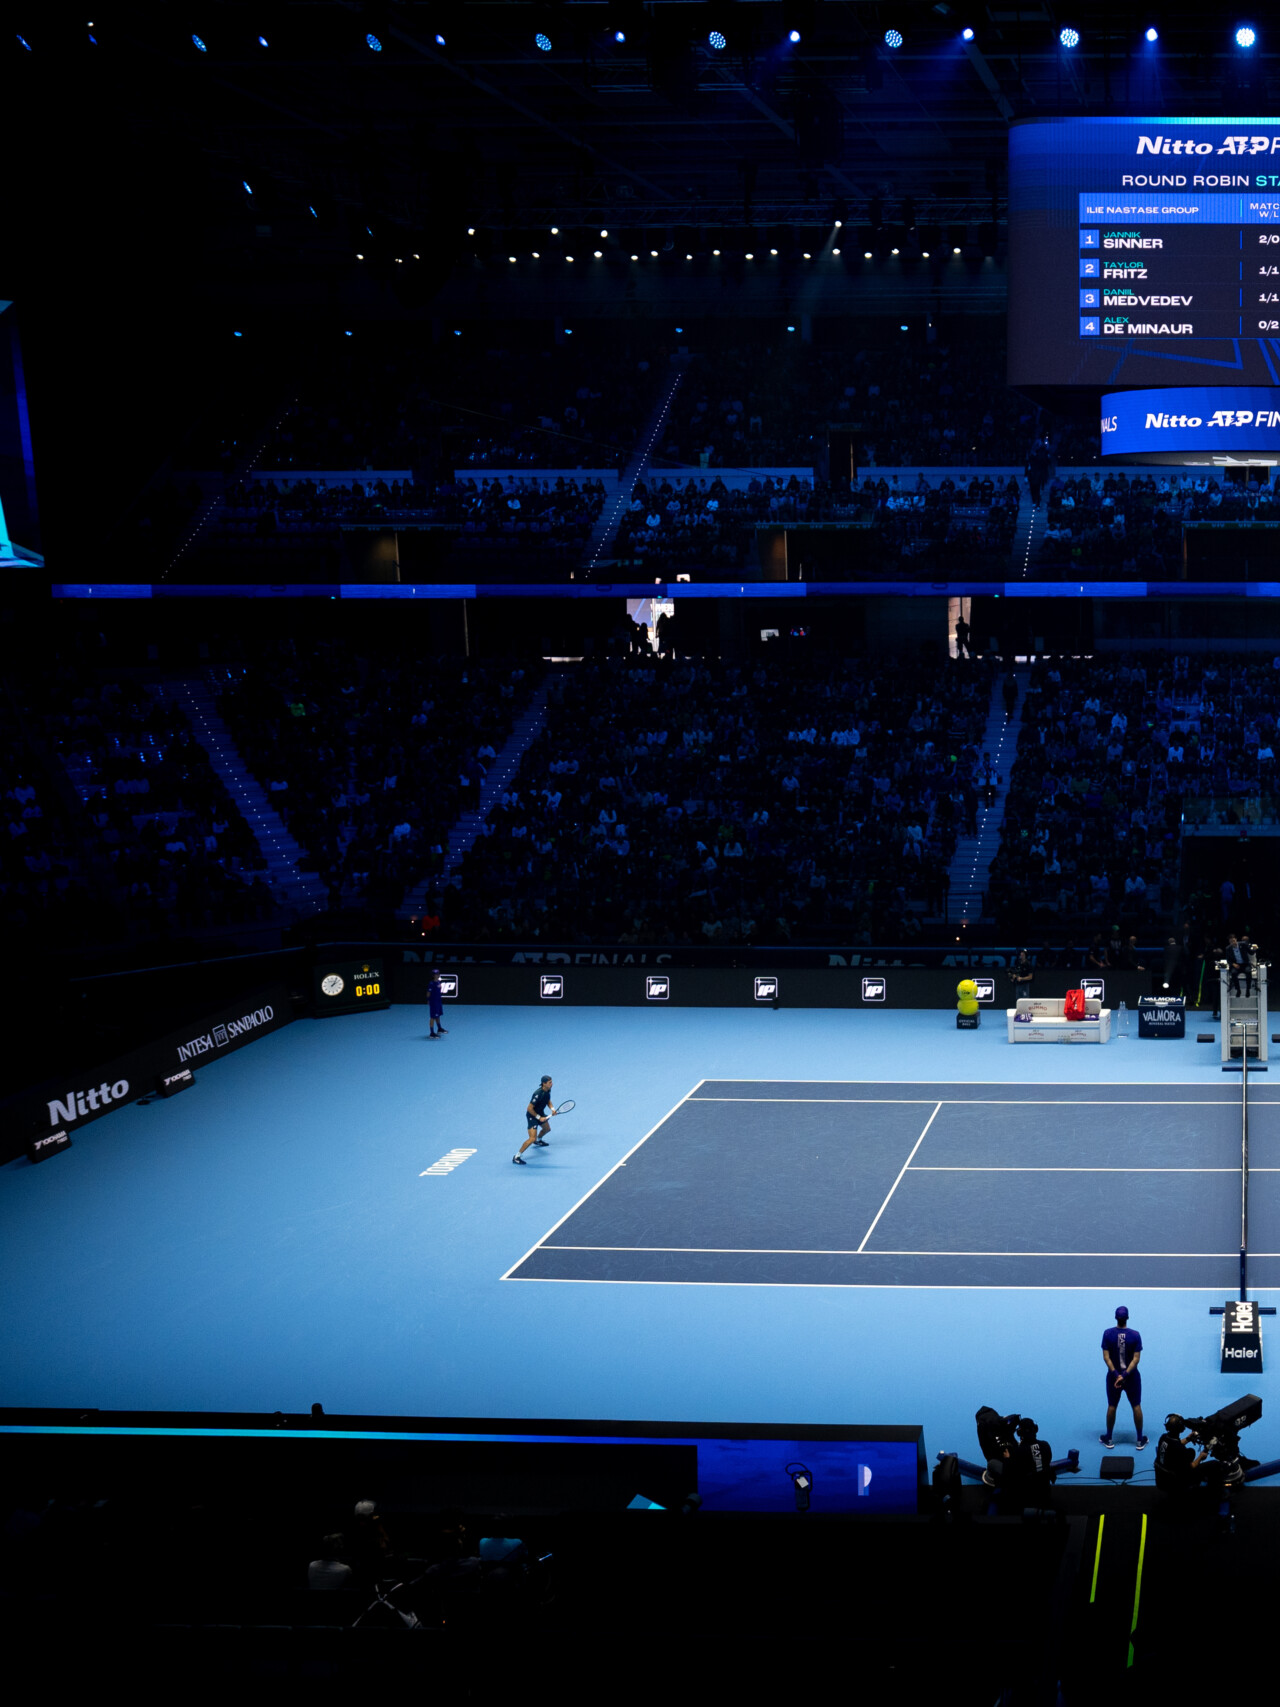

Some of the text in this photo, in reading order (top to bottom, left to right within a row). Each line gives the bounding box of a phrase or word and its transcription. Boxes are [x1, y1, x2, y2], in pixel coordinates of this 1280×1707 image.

[1136, 136, 1213, 154] Nitto
[1215, 136, 1270, 155] ATP
[1122, 175, 1187, 186] ROUND
[1193, 175, 1249, 186] ROBIN
[1086, 206, 1199, 214] ILIE NASTASE GROUP
[1259, 211, 1279, 219] W/L
[1085, 235, 1094, 244] 1
[1103, 238, 1163, 249] SINNER
[1258, 234, 1280, 245] 2/0
[1085, 264, 1094, 273] 2
[1103, 268, 1148, 279] FRITZ
[1258, 265, 1280, 276] 1/1
[1085, 294, 1095, 304] 3
[1103, 295, 1193, 306] MEDVEDEV
[1258, 293, 1280, 303] 1/1
[1085, 322, 1095, 331] 4
[1103, 323, 1193, 334] DE MINAUR
[1258, 320, 1280, 331] 0/2
[1145, 413, 1202, 429] Nitto
[1206, 410, 1254, 427] ATP
[354, 971, 380, 980] ROLEX
[356, 983, 380, 997] 0:00
[1143, 1010, 1181, 1022] VALMORA
[177, 1005, 274, 1062] INTESA SANPAOLO
[47, 1079, 130, 1127] Nitto
[419, 1148, 478, 1177] TORINO
[1230, 1301, 1253, 1332] Haier
[1225, 1347, 1258, 1358] Haier
